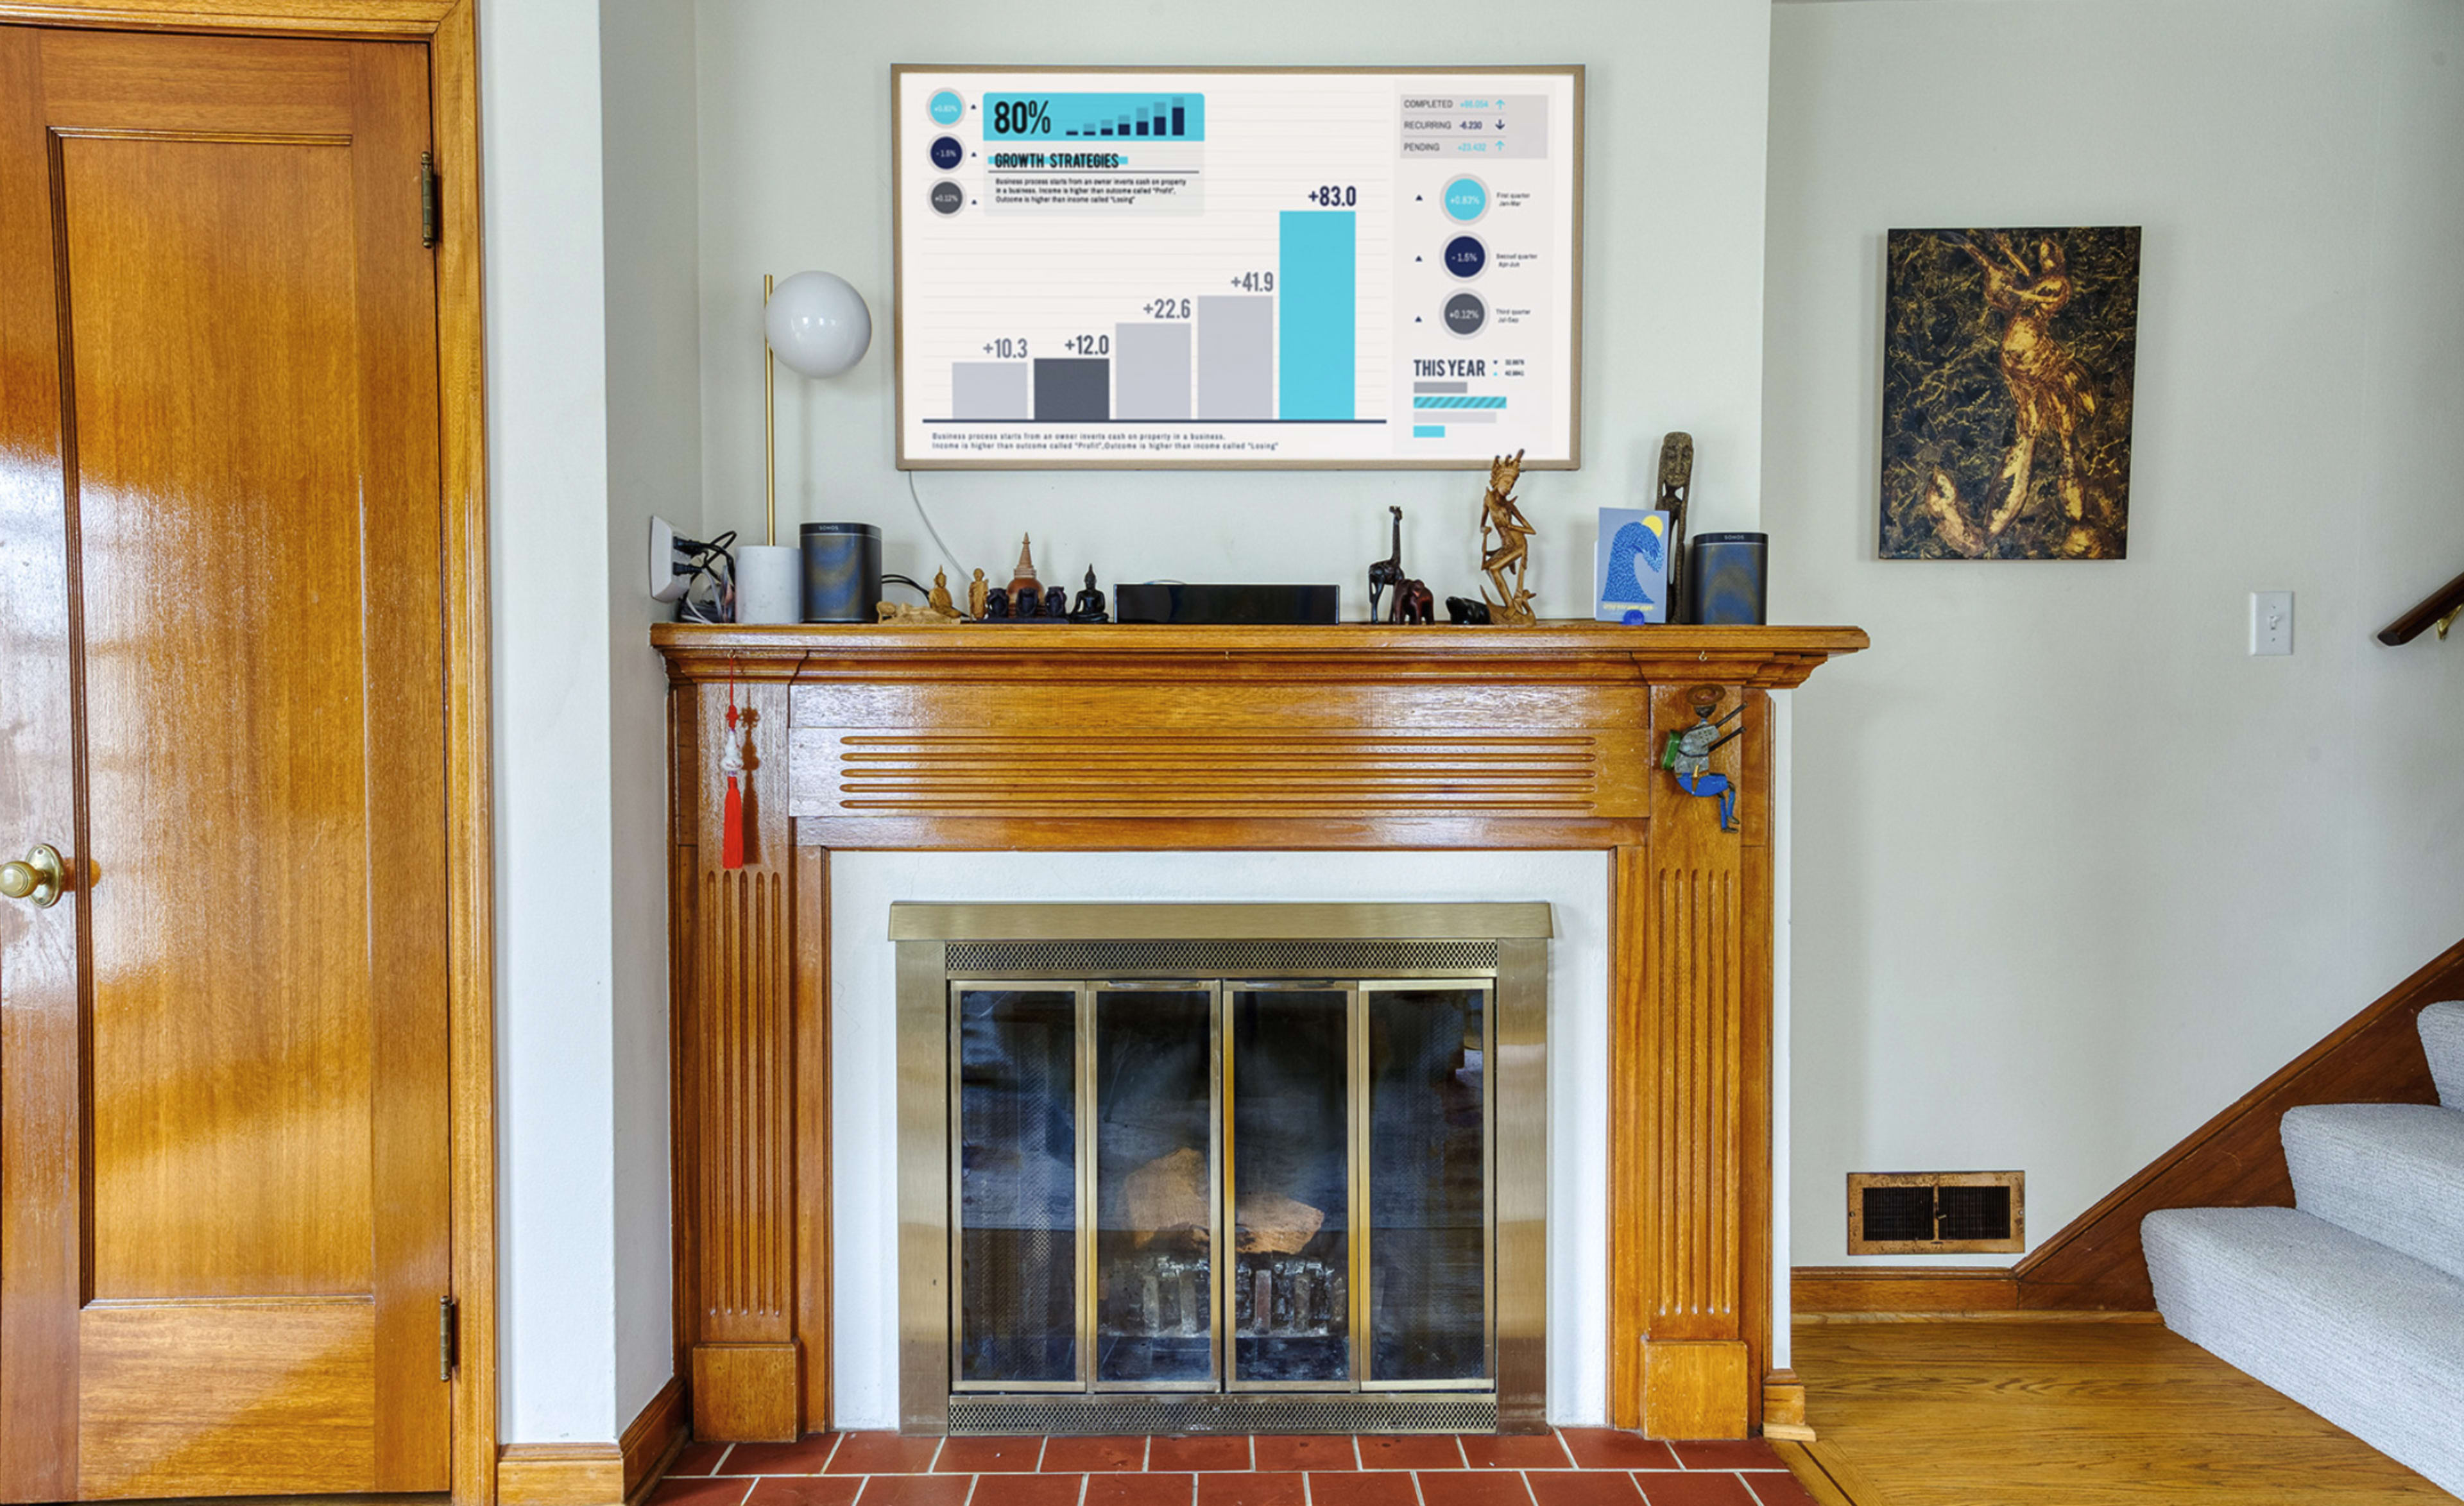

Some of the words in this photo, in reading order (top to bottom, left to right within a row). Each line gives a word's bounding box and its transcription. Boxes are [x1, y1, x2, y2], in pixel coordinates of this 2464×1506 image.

[1404, 99, 1453, 108] COMPLETED
[994, 100, 1051, 134] 80%
[1404, 121, 1451, 130] RECURRING
[1404, 142, 1440, 151] PENDING
[995, 153, 1045, 168] GROWTH
[1049, 153, 1120, 169] STRATEGIES
[1070, 187, 1088, 195] higher
[1308, 185, 1357, 207] +83.0
[995, 195, 1023, 203] Outcome
[1031, 196, 1050, 205] higher
[1231, 271, 1274, 293] +41.9
[1143, 298, 1192, 320] +22.6
[1450, 309, 1479, 320] +0.12%
[982, 338, 1029, 359] +10.3
[1064, 334, 1110, 356] +12.0
[1414, 359, 1446, 377] THIS
[1448, 359, 1486, 377] YEAR
[932, 432, 966, 440] Business
[968, 433, 998, 441] process
[1139, 433, 1171, 441] property
[1190, 432, 1226, 441] business.
[971, 442, 994, 450] higher
[1149, 442, 1172, 450] higher
